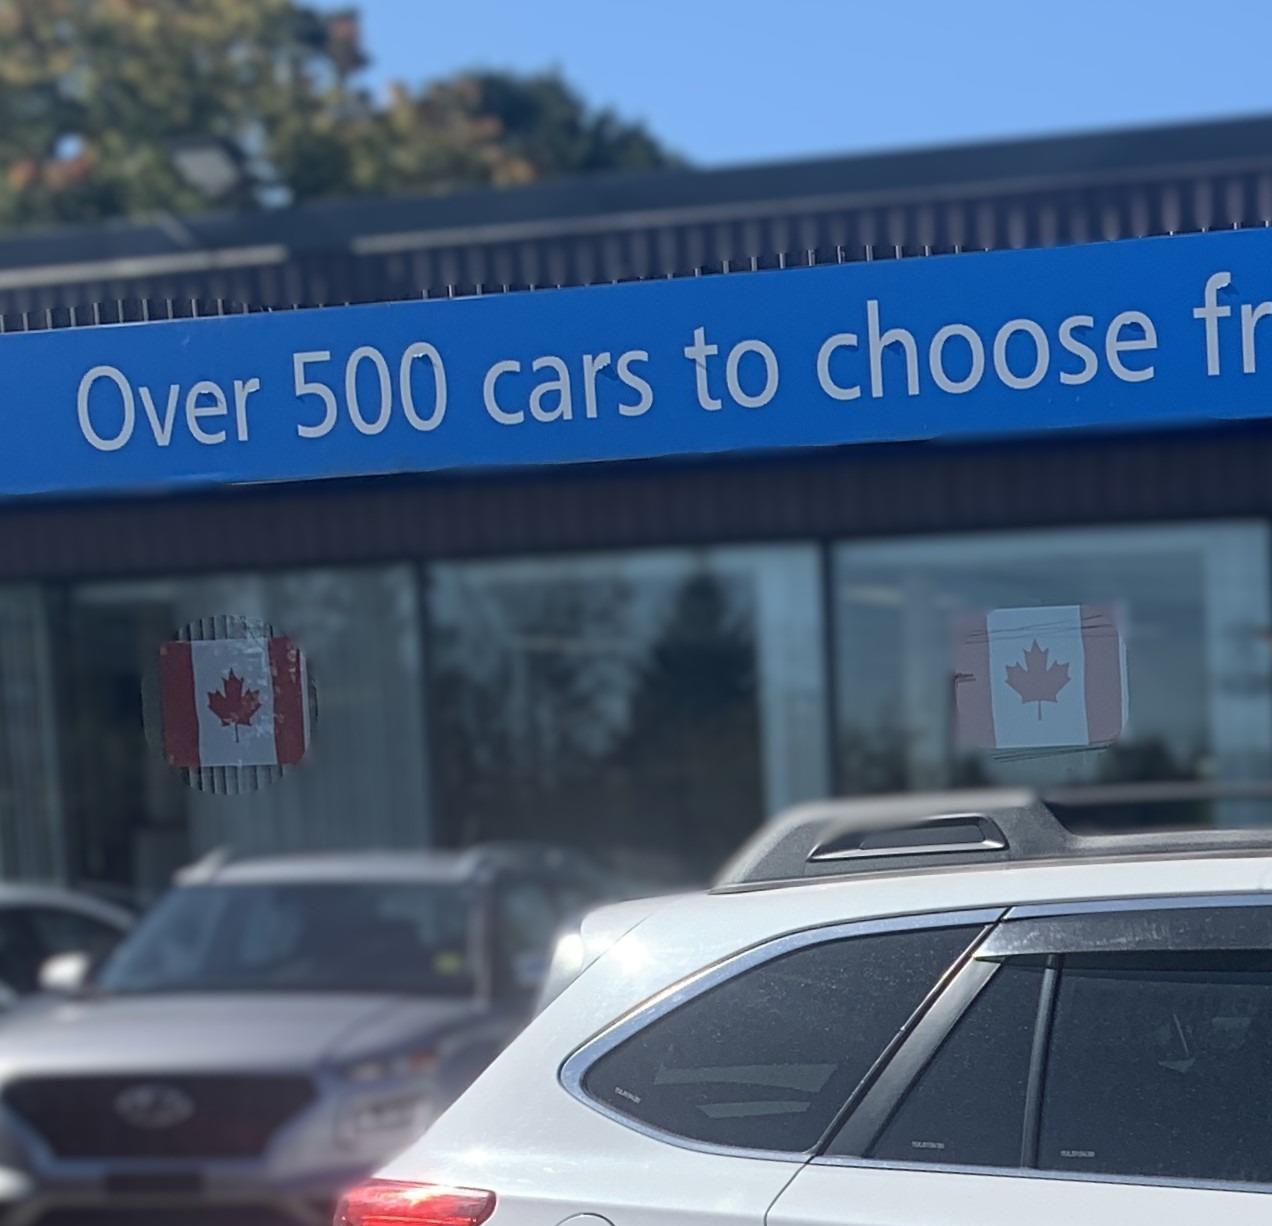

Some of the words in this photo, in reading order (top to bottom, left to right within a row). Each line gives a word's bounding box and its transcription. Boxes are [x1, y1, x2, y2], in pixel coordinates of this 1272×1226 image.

[77, 365, 260, 451] Over
[293, 342, 447, 439] 500
[482, 348, 654, 425] cars
[684, 326, 779, 411] to
[817, 299, 1157, 400] choose
